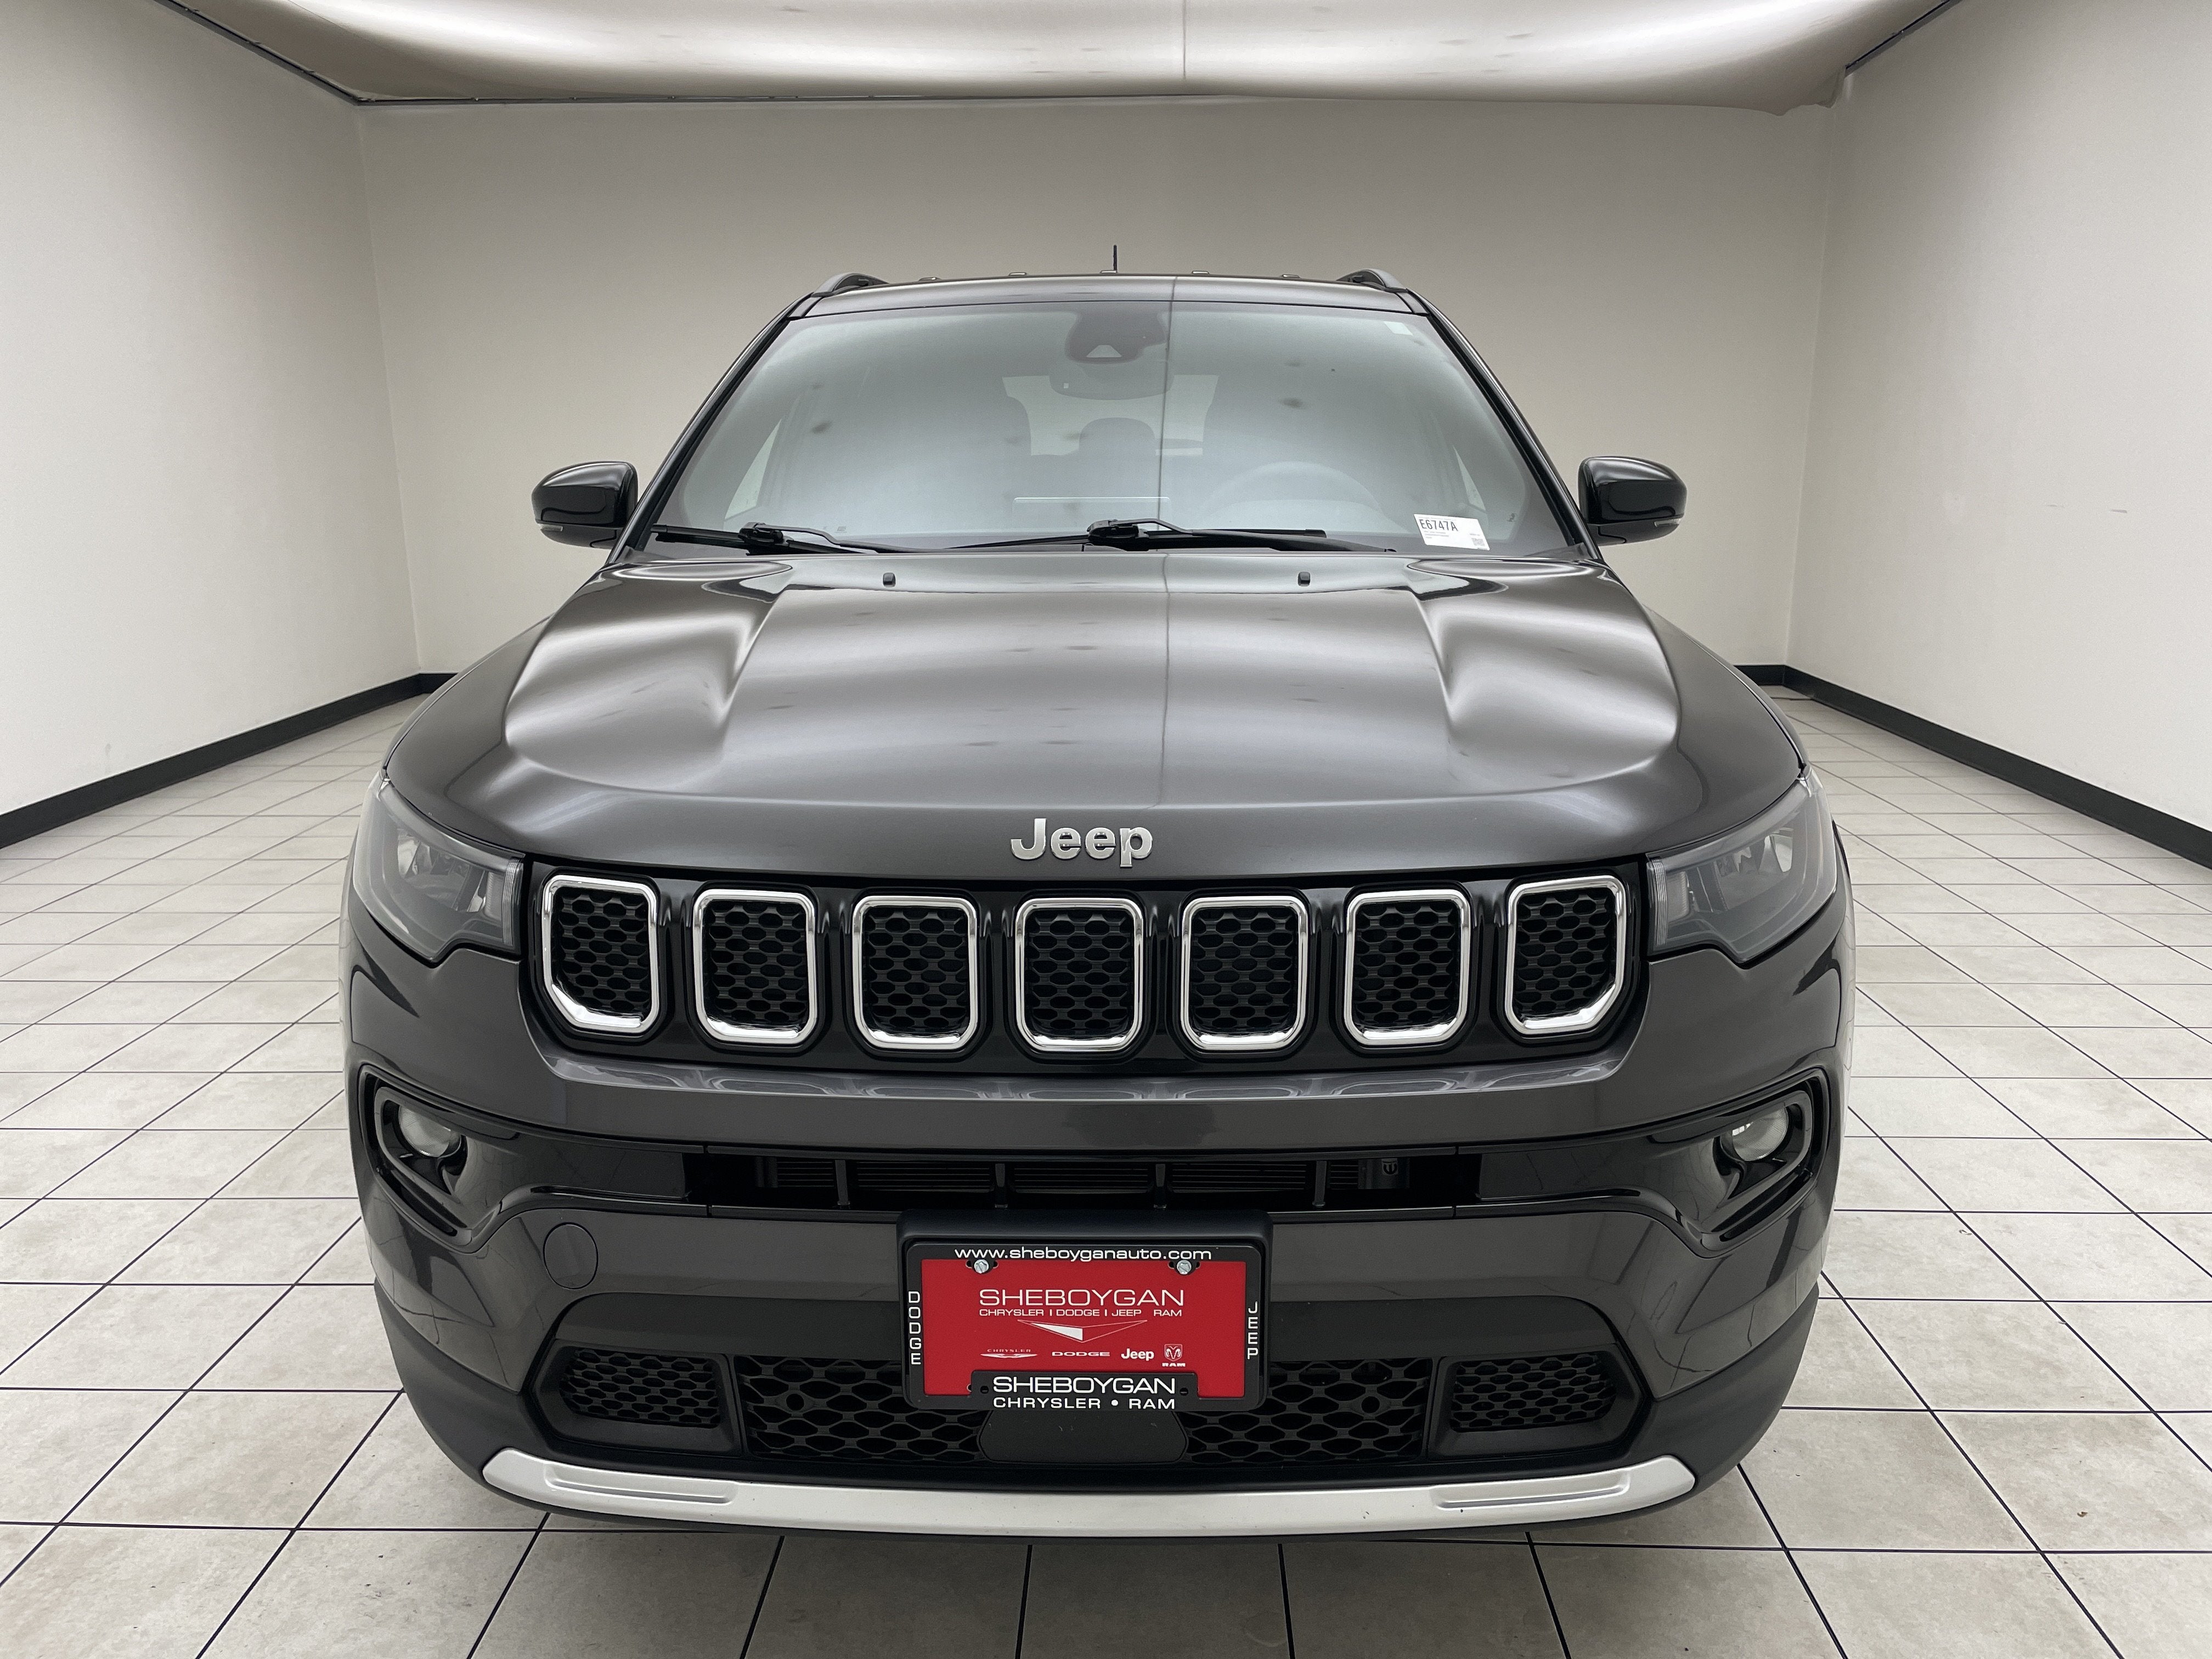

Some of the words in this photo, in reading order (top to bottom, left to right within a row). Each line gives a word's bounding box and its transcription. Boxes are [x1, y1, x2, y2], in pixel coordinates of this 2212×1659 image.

[1419, 519, 1458, 532] E6747A
[1011, 818, 1153, 868] Jeep
[955, 1246, 1211, 1262] www.sheboyganauto.com
[979, 1289, 1184, 1306] SHEBOYGAN
[909, 1291, 922, 1365] DODGE
[1247, 1301, 1259, 1360] JEEP
[1121, 1348, 1154, 1361] Jeep
[993, 1376, 1175, 1394] SHEBOYGAN
[993, 1397, 1101, 1409] CHRYSLER
[1129, 1398, 1175, 1409] RAM
